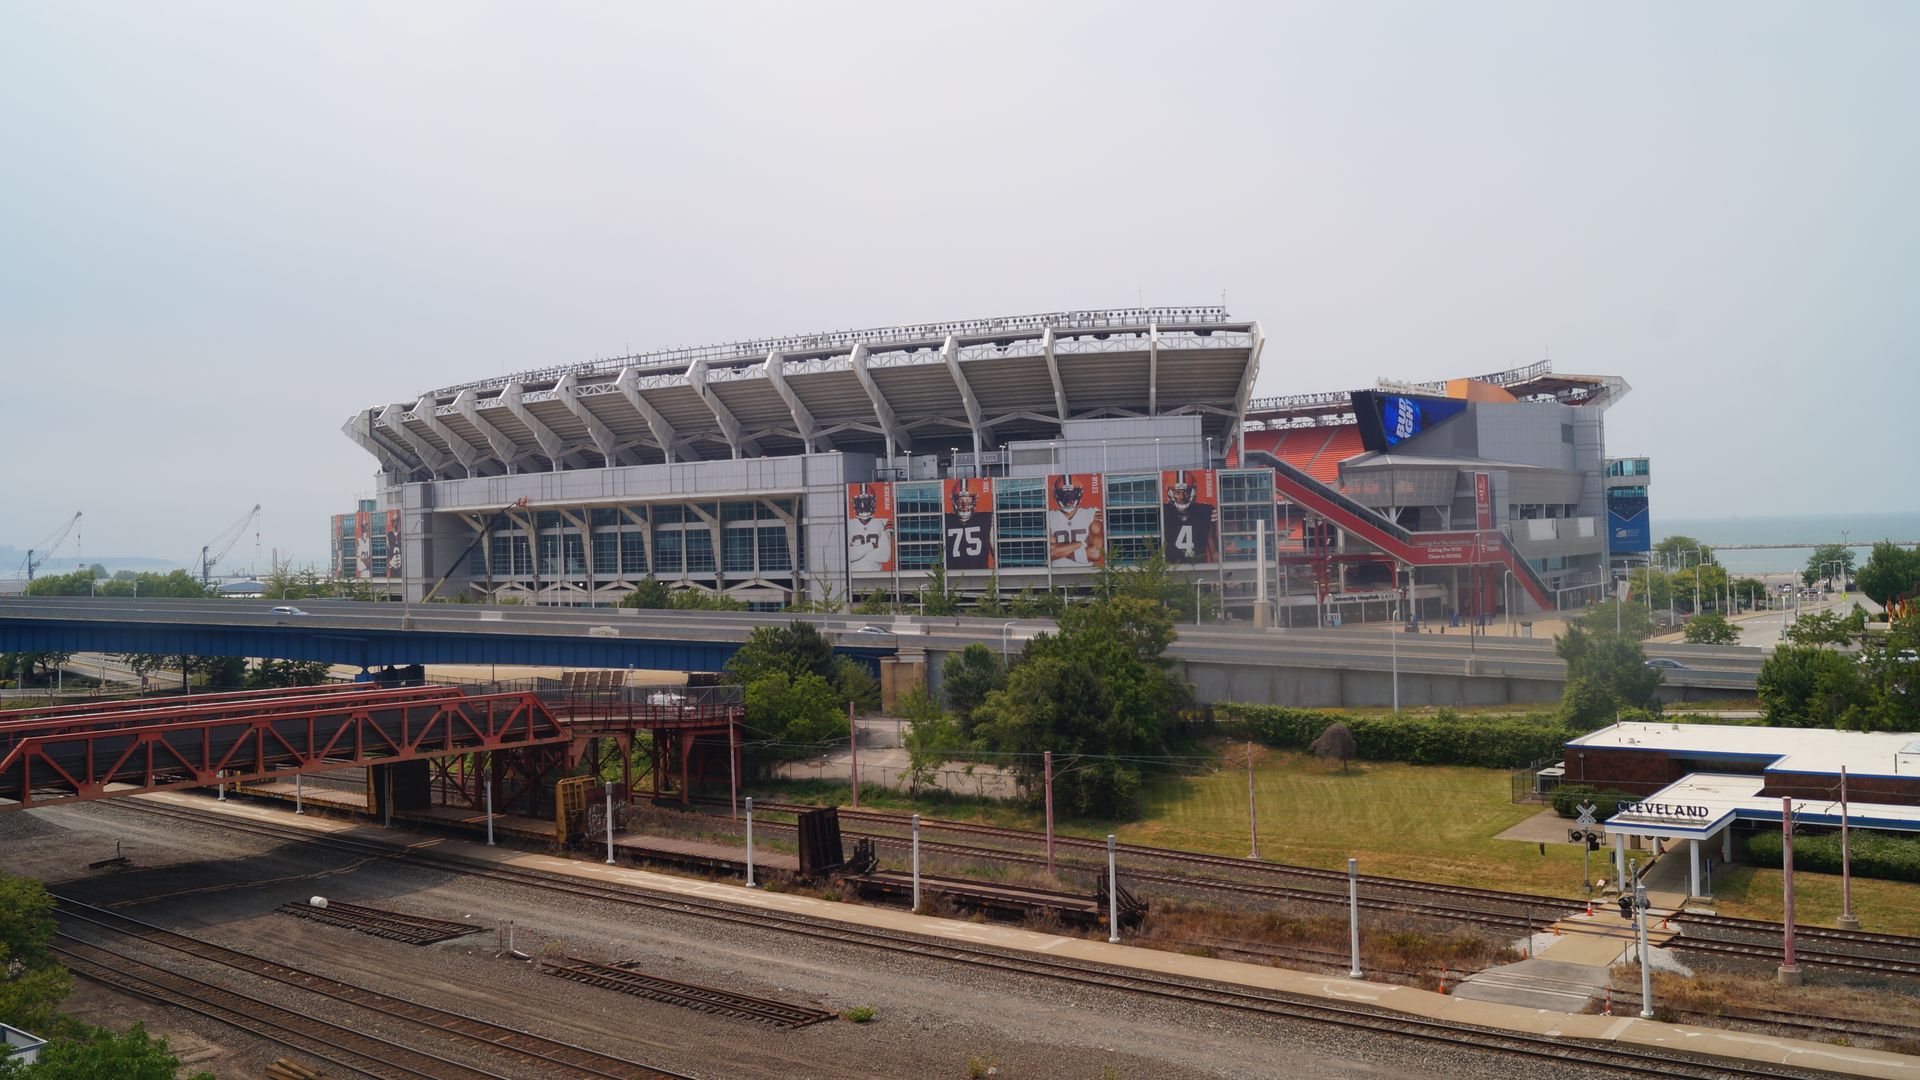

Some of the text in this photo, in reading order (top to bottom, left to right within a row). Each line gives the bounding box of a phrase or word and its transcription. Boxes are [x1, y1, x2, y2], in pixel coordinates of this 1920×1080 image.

[1395, 397, 1407, 439] BUD
[1403, 398, 1414, 439] IGHT
[948, 526, 982, 558] 75
[1175, 525, 1194, 557] 4
[1616, 800, 1709, 818] CLEVELAND
